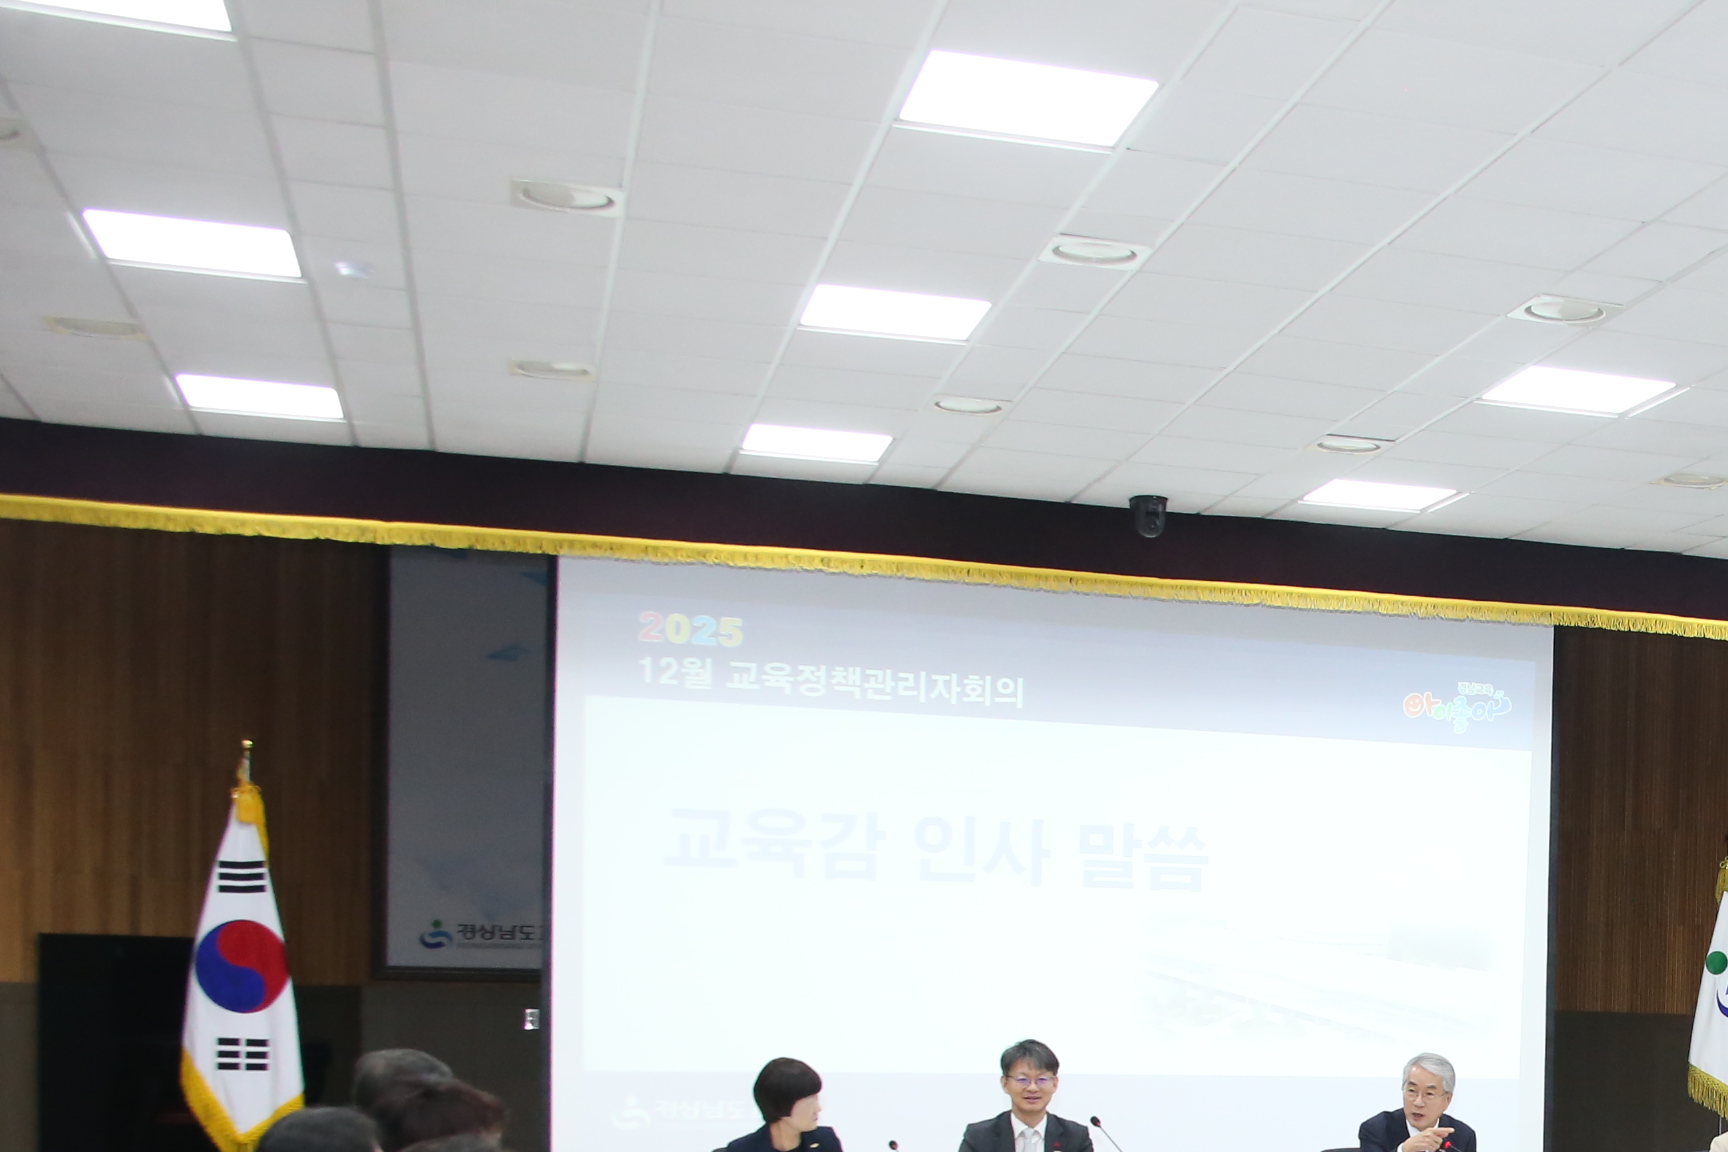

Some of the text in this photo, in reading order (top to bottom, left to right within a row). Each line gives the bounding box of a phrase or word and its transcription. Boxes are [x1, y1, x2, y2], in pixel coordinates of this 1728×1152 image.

[638, 611, 744, 647] 2025
[638, 656, 1024, 708] 12월 교육정책관리자회의
[663, 806, 1209, 892] 교육감 인사 말씀
[457, 924, 541, 941] 경상남도
